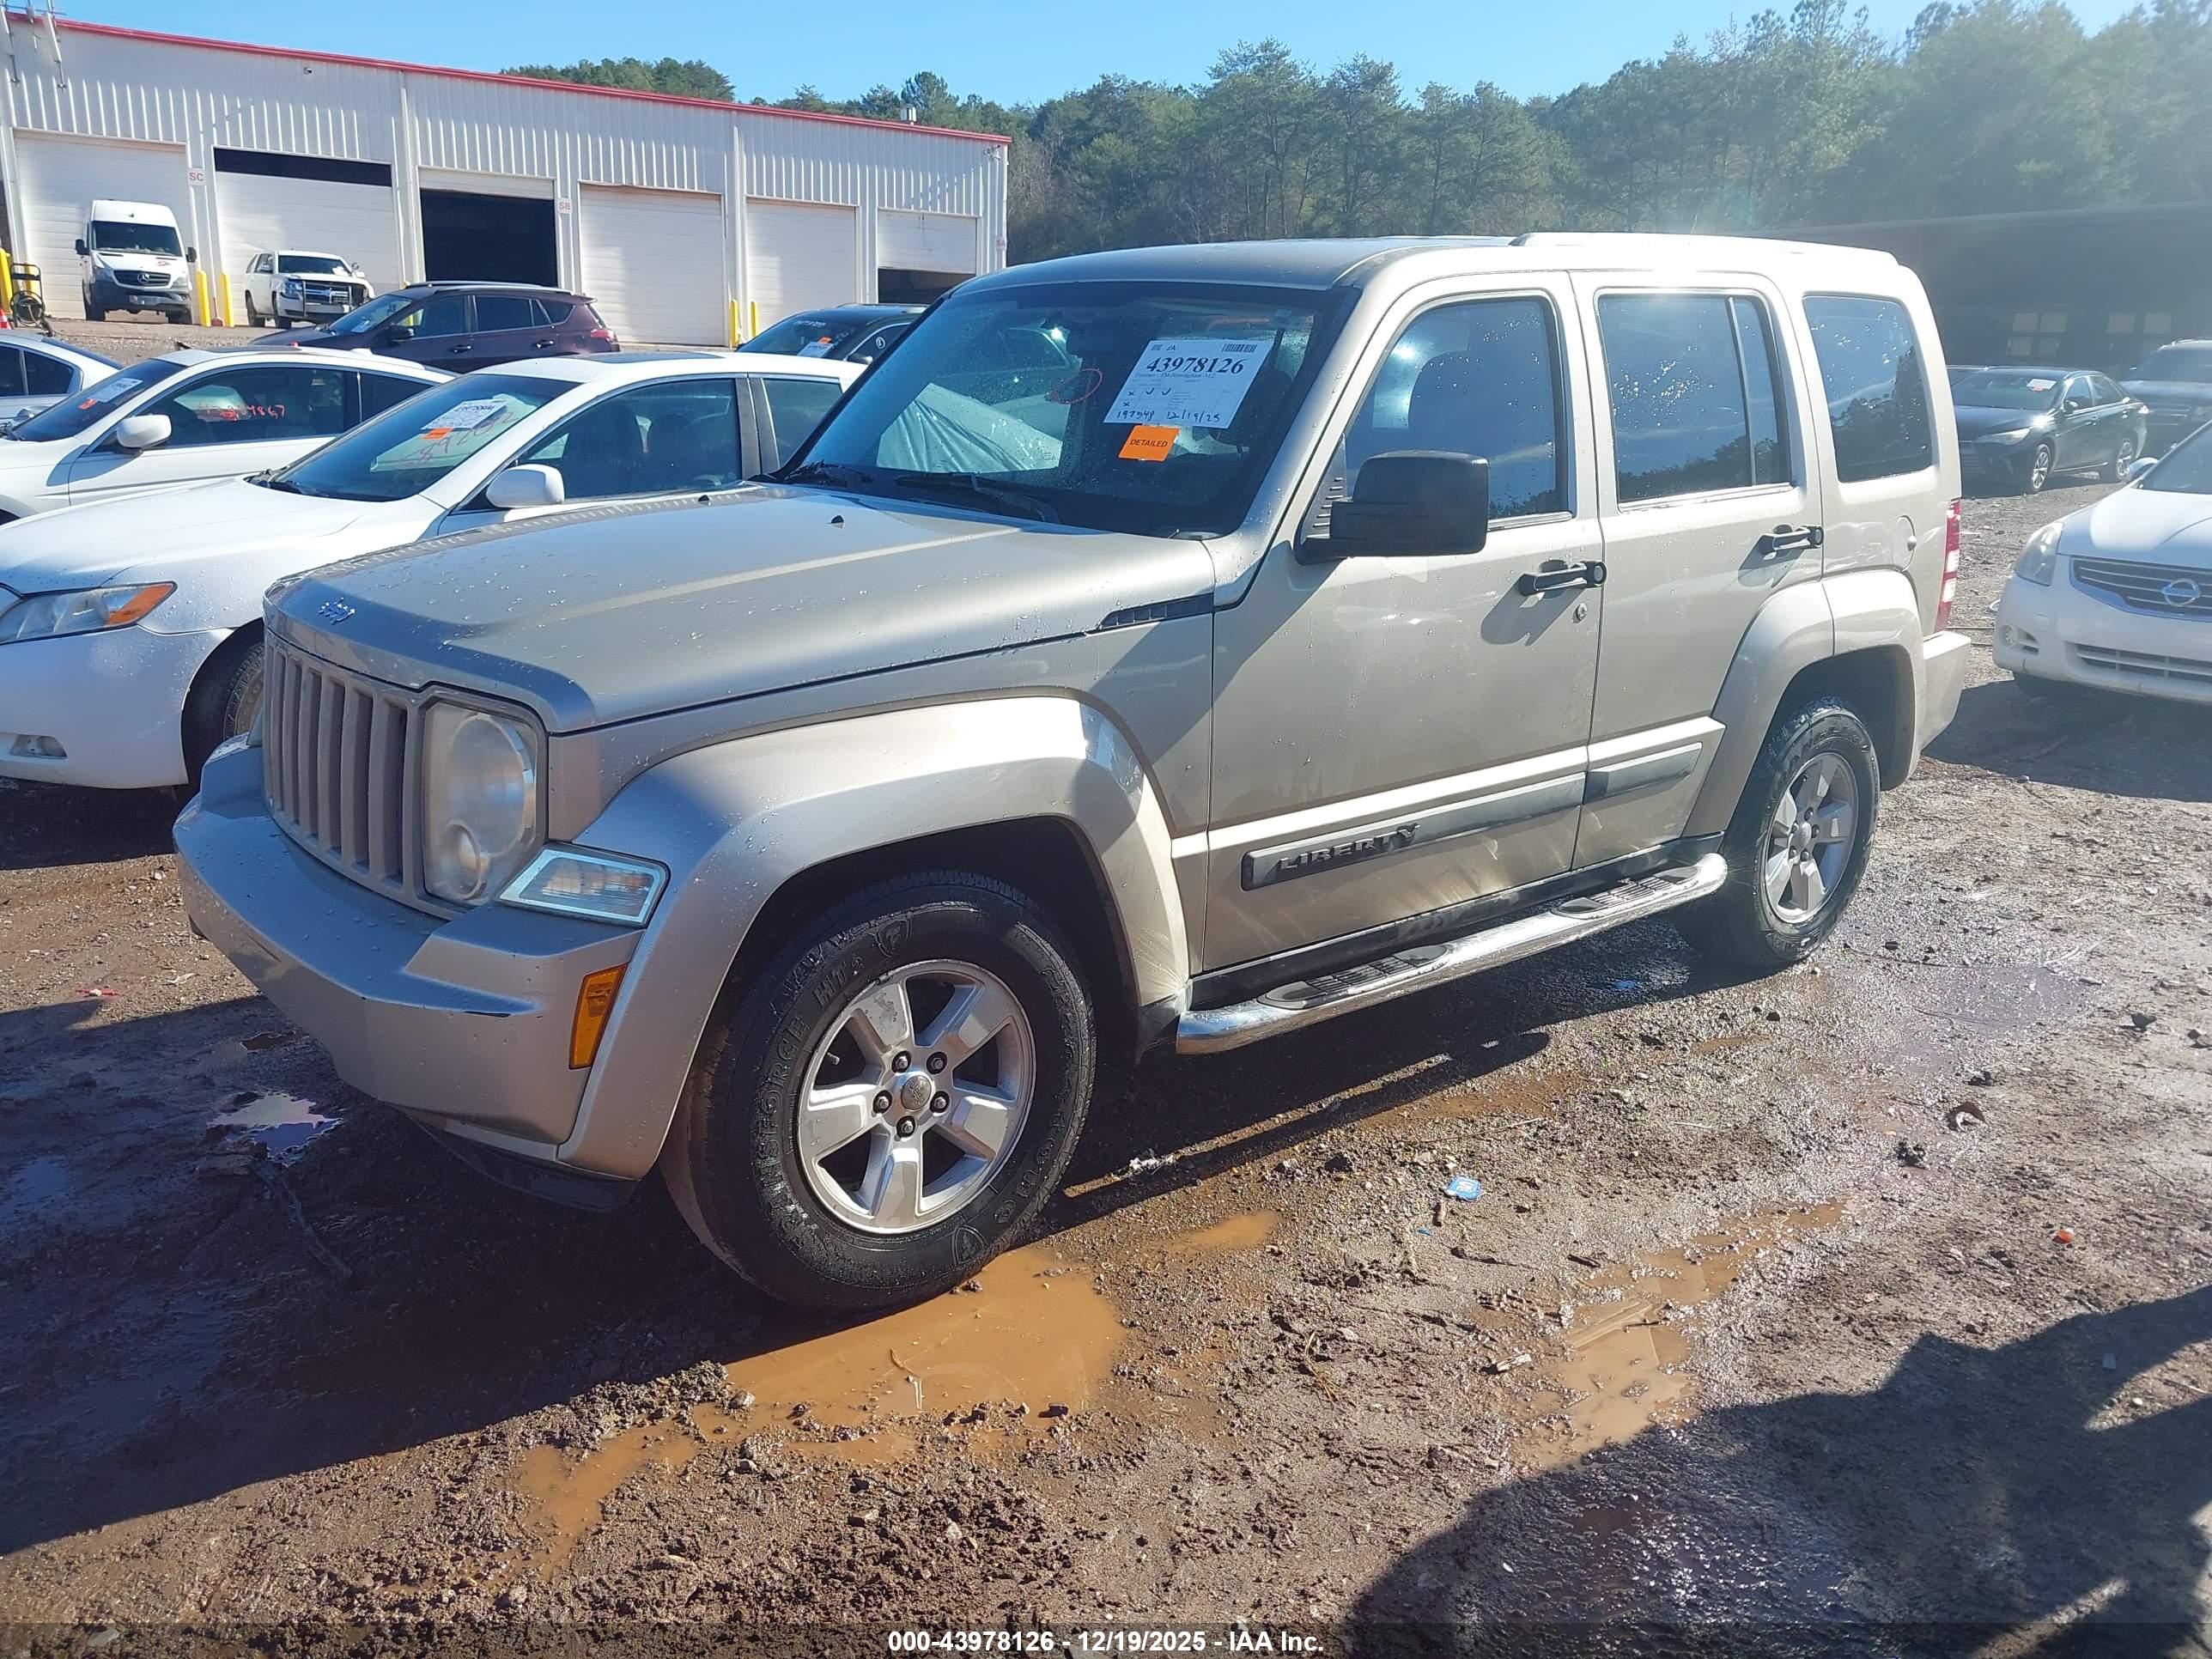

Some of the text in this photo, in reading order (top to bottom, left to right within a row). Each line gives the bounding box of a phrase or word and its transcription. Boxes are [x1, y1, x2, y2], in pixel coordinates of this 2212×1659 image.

[189, 172, 204, 181] SC
[1146, 356, 1247, 374] 43978126
[1129, 439, 1168, 447] DETAILED
[1279, 823, 1421, 871] LIBERTY
